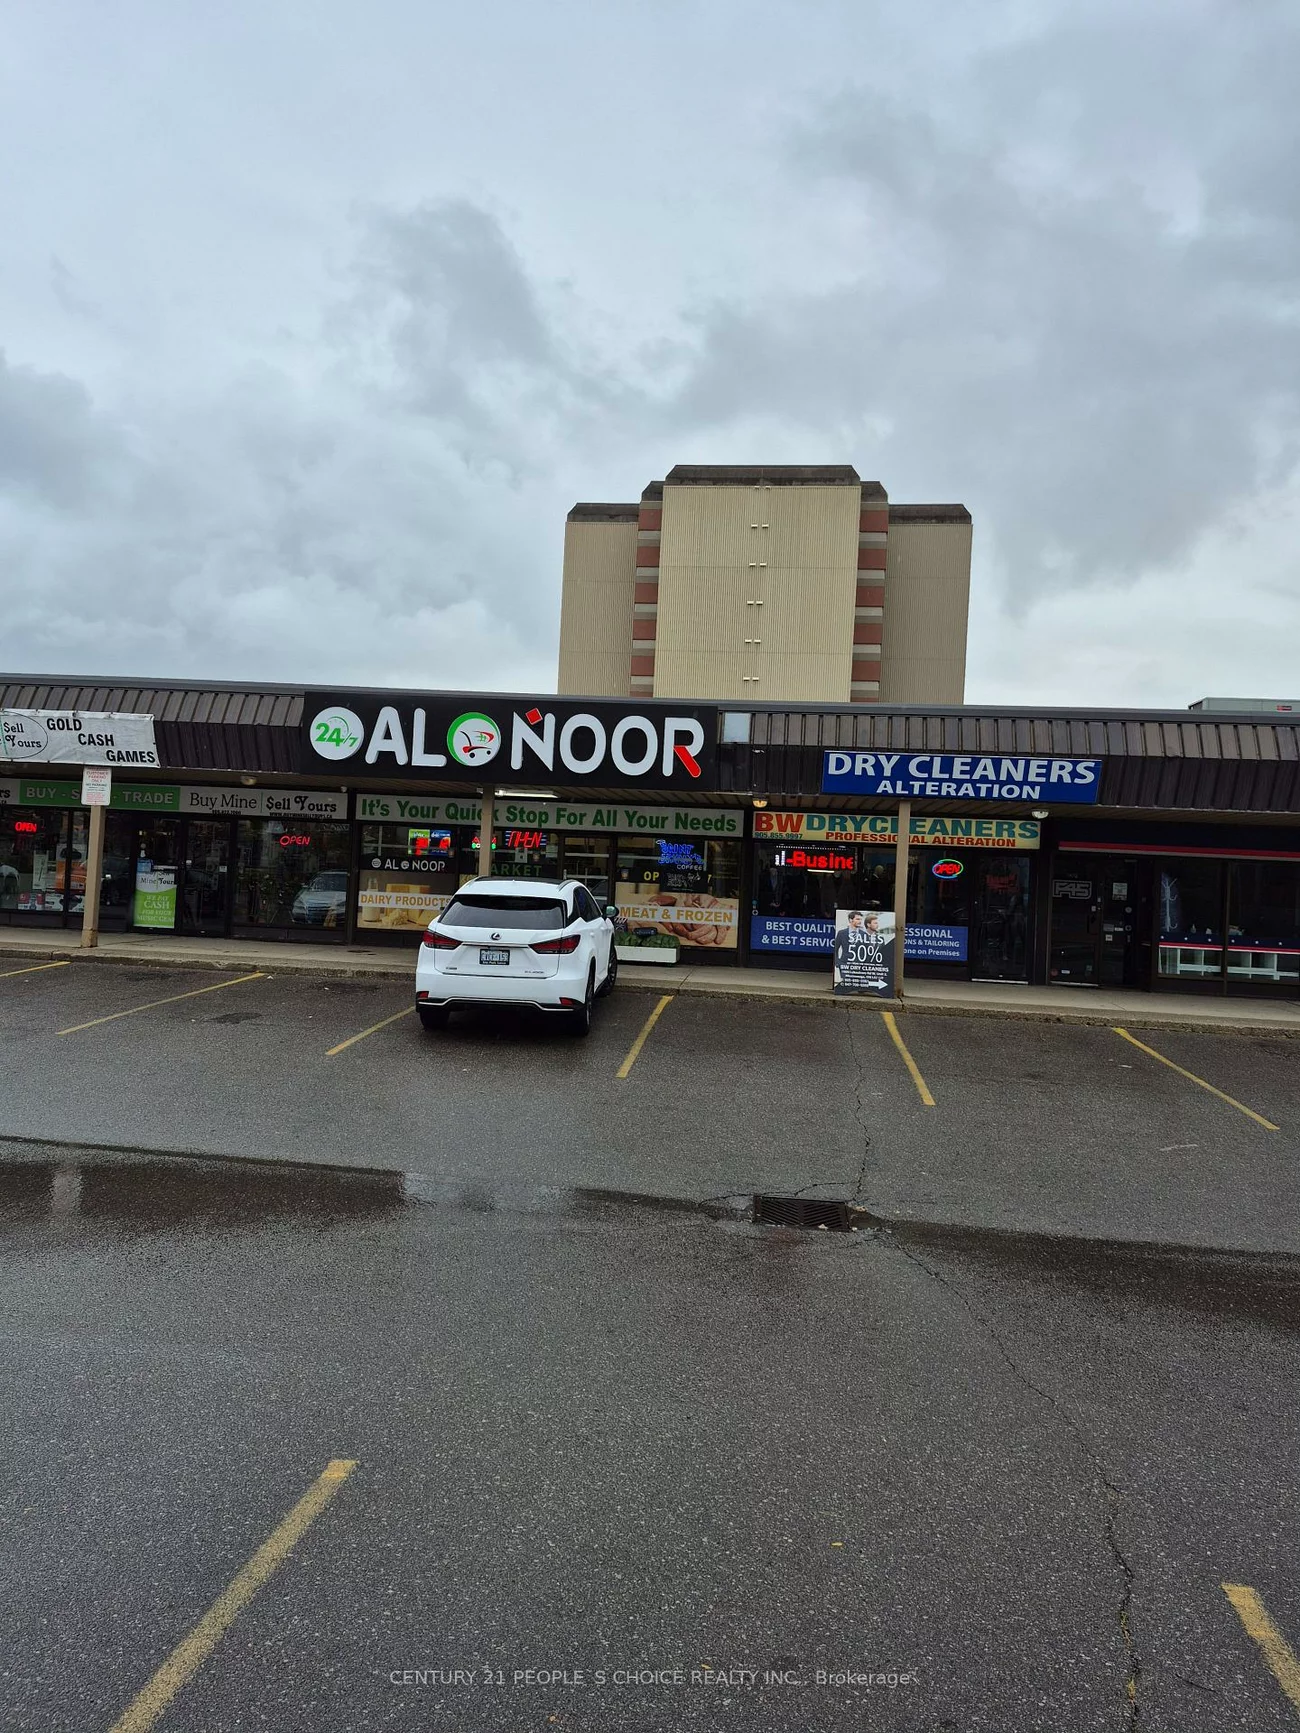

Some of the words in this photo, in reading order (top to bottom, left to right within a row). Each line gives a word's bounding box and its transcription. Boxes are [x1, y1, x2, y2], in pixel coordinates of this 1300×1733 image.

[46, 717, 83, 732] GOLD
[5, 735, 42, 748] Yours
[78, 733, 115, 747] CASH
[315, 722, 358, 748] 24/7
[364, 706, 447, 766] AL
[510, 708, 704, 778] NOOR
[106, 750, 156, 764] GAMES
[827, 753, 901, 778] DRY
[908, 756, 1097, 785] CLEANERS
[26, 786, 56, 799] BUY
[122, 791, 174, 804] TRADE
[876, 780, 1041, 801] ALTERATION
[189, 792, 218, 810] Buy
[221, 794, 257, 809] Mine
[294, 795, 337, 813] Yours
[361, 798, 390, 818] It's
[397, 800, 440, 820] Your
[505, 805, 549, 828] Stop
[555, 807, 587, 826] For
[592, 808, 617, 828] All
[624, 810, 669, 830] Your
[674, 812, 737, 833] Needs
[754, 812, 804, 833] BW
[15, 821, 37, 832] OPEN
[279, 834, 312, 847] OPEN
[825, 831, 929, 846] PROFESSIOAL
[931, 836, 1016, 848] ALTERATION
[384, 858, 400, 870] AL
[477, 862, 543, 876] ARKET
[934, 862, 961, 875] OPEN
[159, 878, 176, 886] Your
[143, 901, 170, 910] CASH
[360, 894, 393, 907] DAIRY
[395, 895, 451, 908] PRODUCTS
[619, 907, 657, 919] MEAT
[661, 908, 671, 920] &
[676, 909, 733, 923] FROZEN
[766, 921, 791, 932] BEST
[904, 927, 953, 939] ESSIONAL
[761, 934, 770, 944] &
[771, 935, 798, 945] BEST
[800, 936, 836, 948] SERVIC
[848, 933, 884, 945] SALES
[924, 939, 960, 948] TAILORING
[847, 944, 883, 963] 50%
[928, 948, 960, 957] Premises
